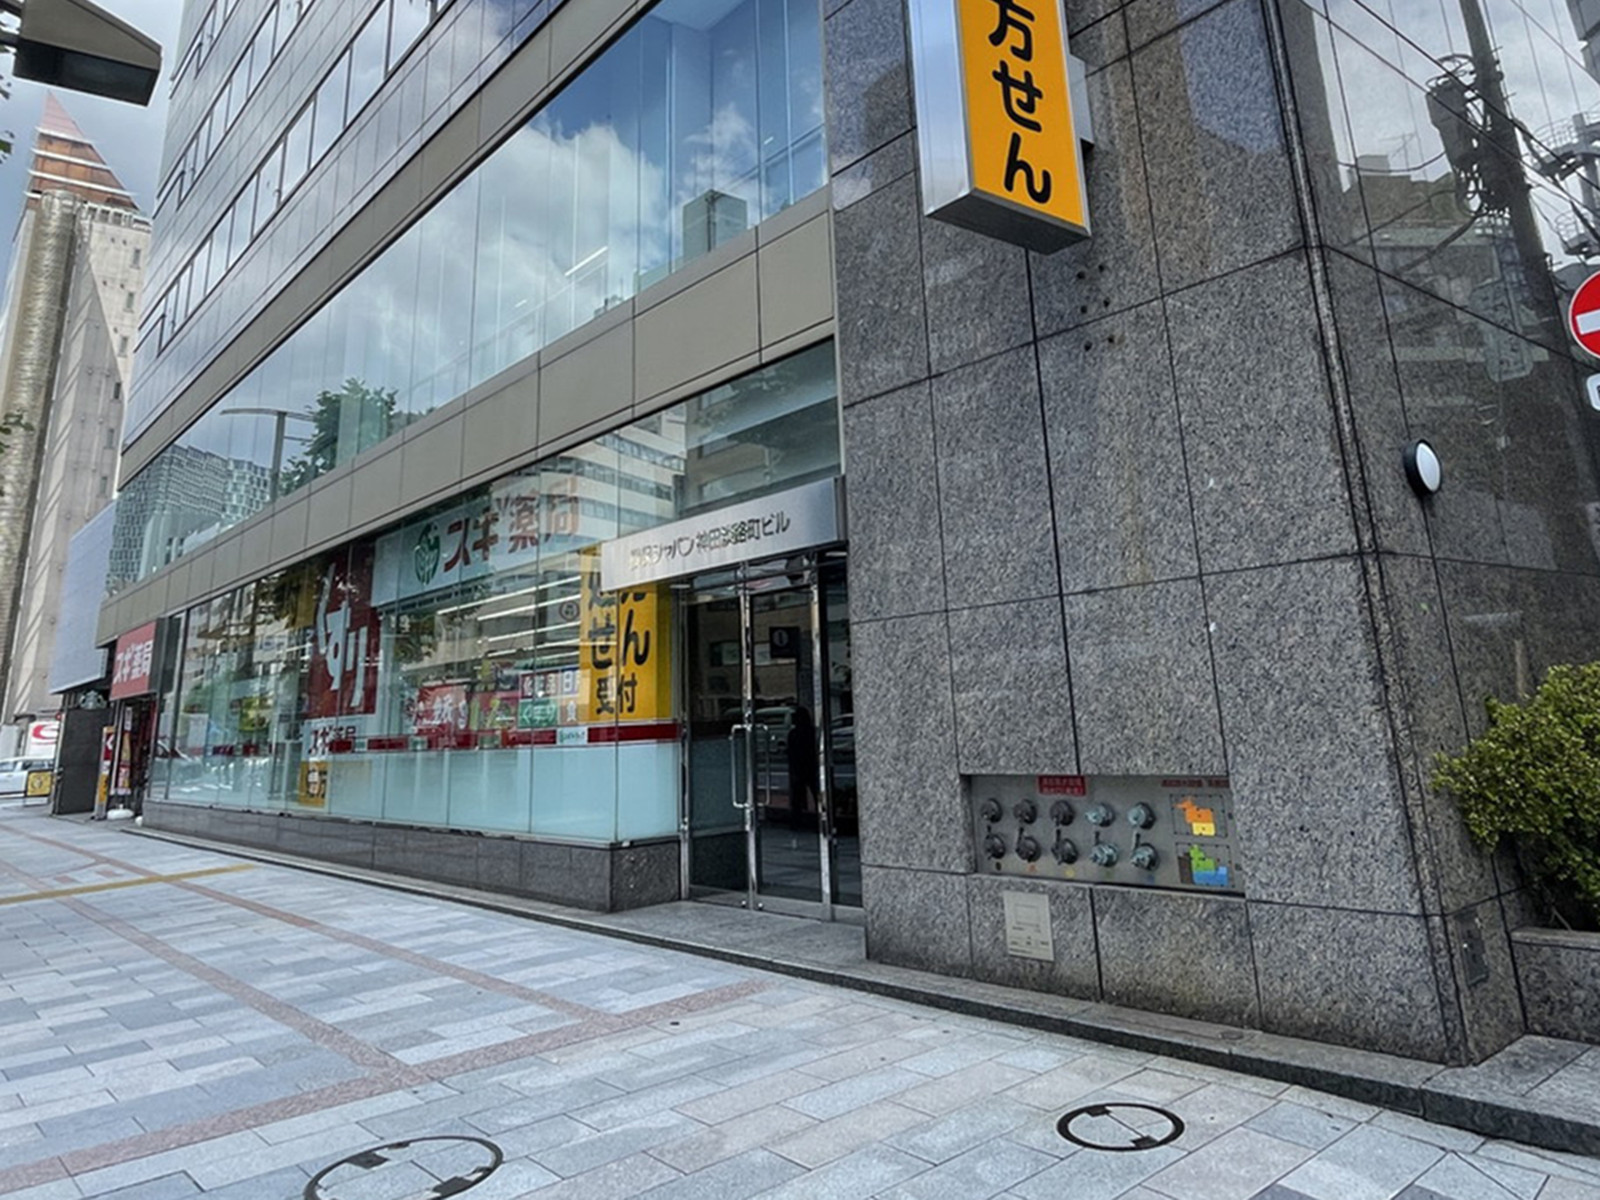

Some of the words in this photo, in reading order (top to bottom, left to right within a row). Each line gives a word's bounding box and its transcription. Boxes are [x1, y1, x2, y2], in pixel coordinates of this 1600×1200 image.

[443, 476, 580, 573] スギ薬局
[113, 640, 154, 685] スギ薬局
